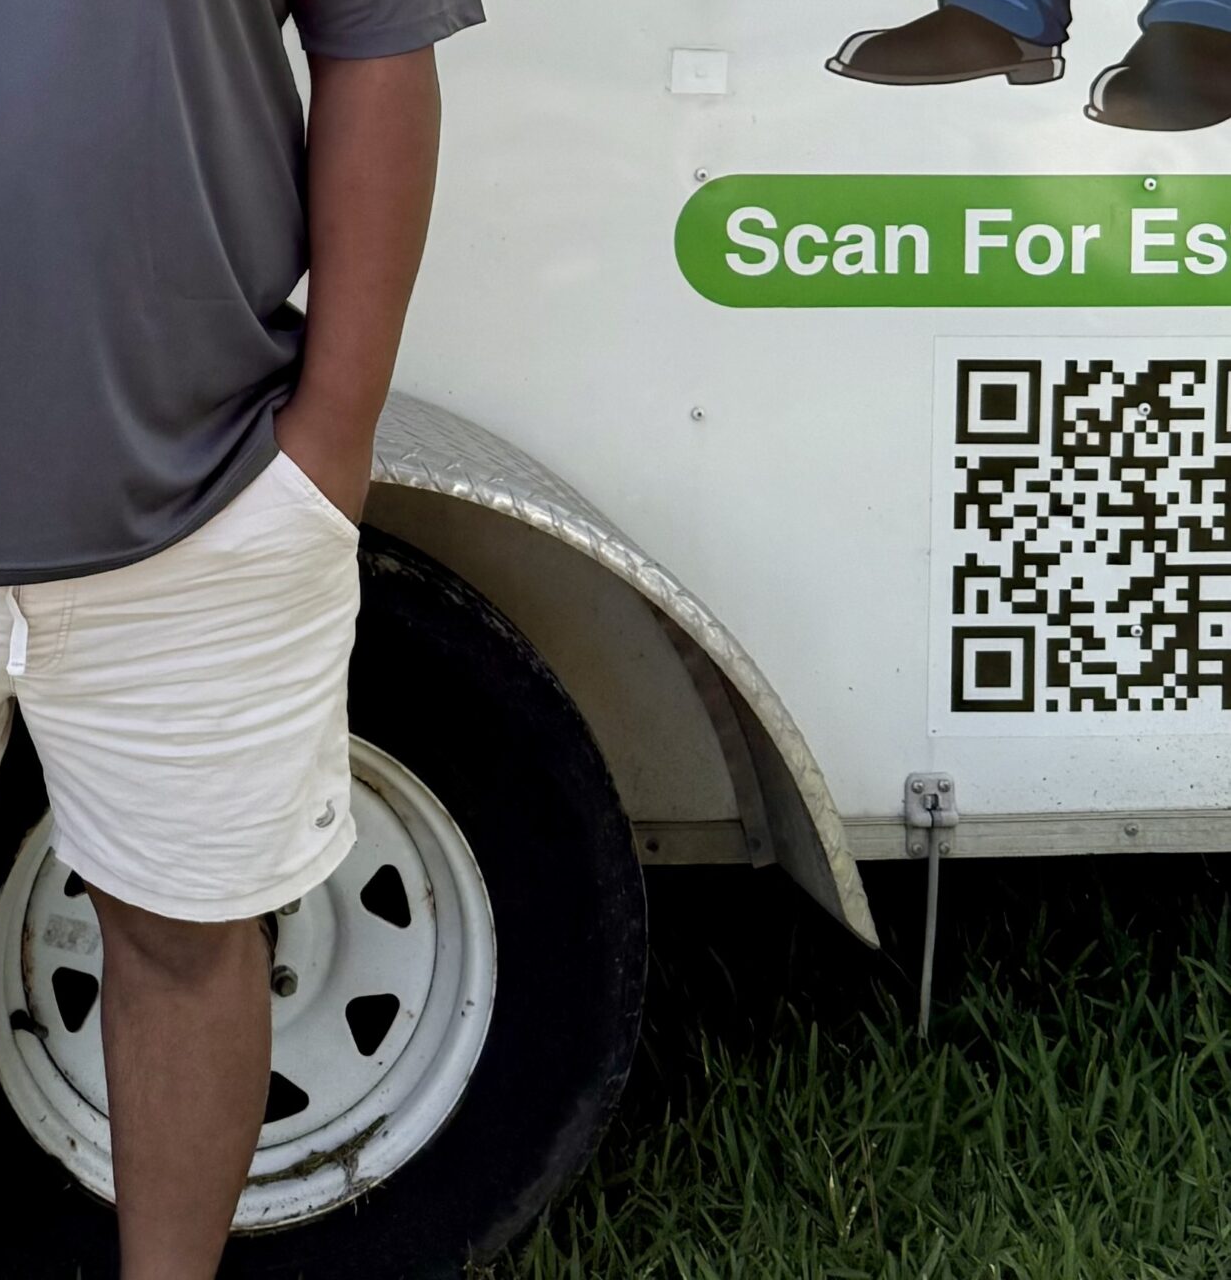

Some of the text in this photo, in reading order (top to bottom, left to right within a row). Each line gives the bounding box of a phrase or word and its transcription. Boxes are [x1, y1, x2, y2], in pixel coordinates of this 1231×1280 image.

[725, 206, 1231, 276] Scan For Es
